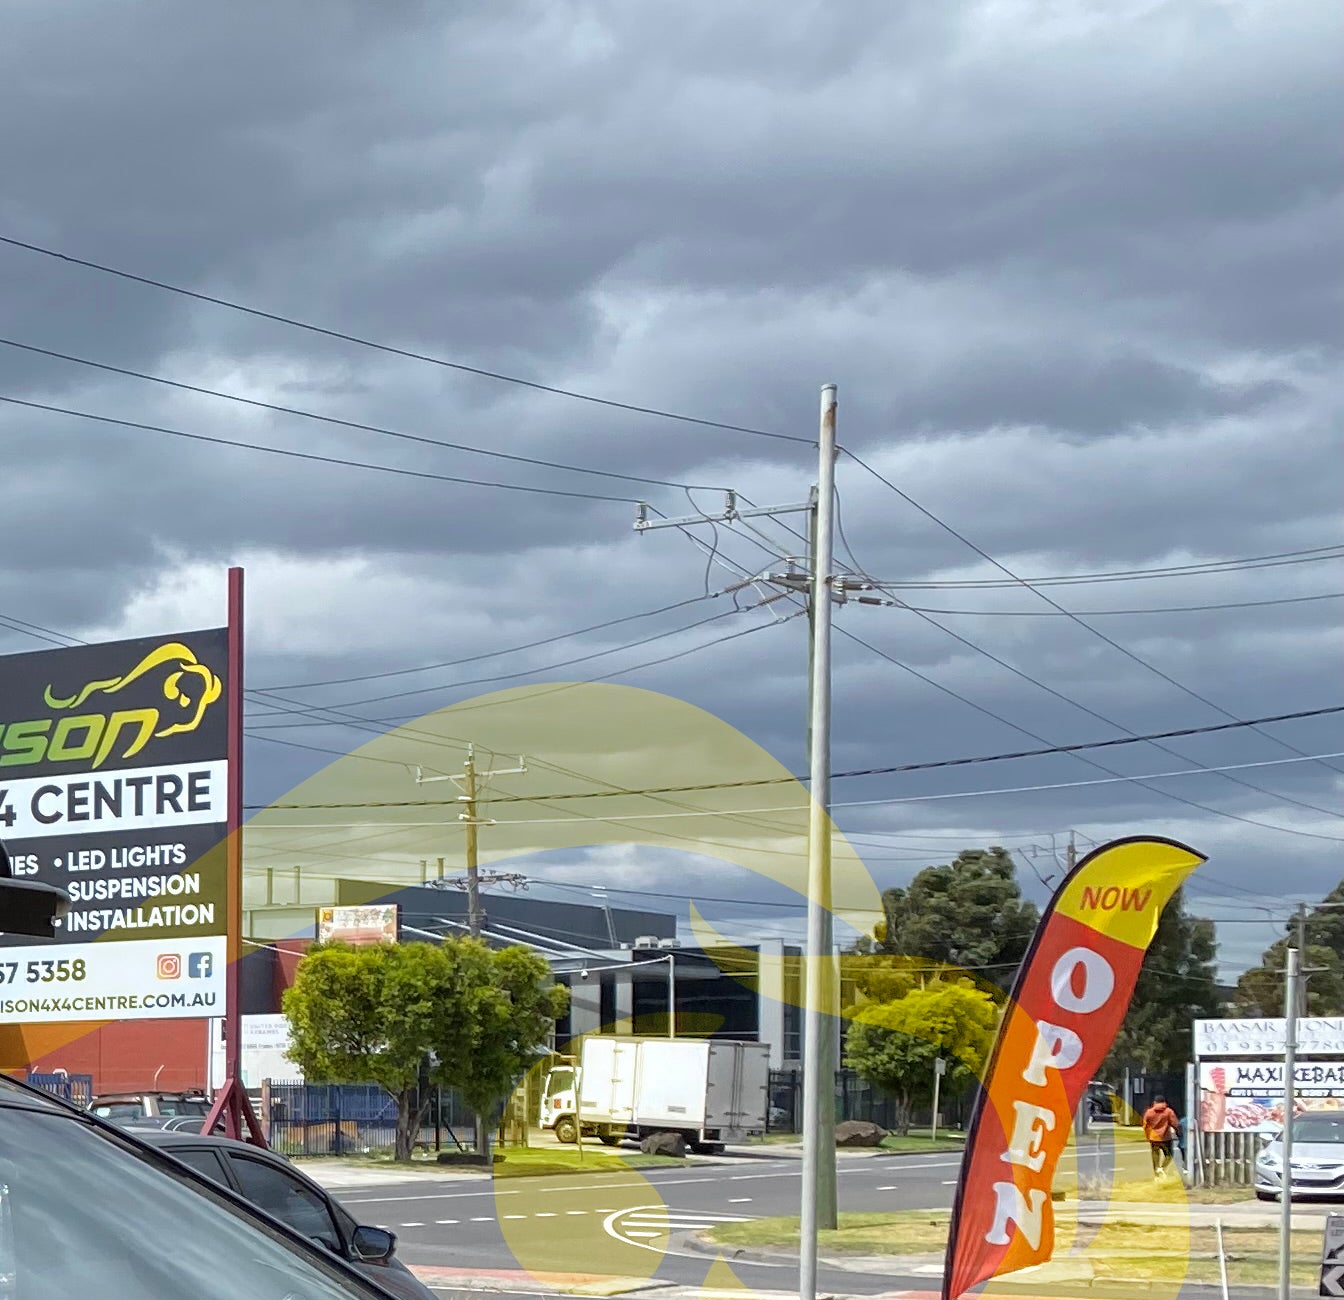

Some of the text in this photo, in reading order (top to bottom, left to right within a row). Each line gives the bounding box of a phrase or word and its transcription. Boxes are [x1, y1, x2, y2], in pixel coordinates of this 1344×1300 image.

[30, 770, 211, 824] CENTRE
[67, 843, 187, 872] LED LIGHTS
[67, 872, 200, 902] SUSPENSION
[1079, 886, 1152, 912] NOW
[67, 902, 215, 932] INSTALLATION
[25, 958, 87, 983] 5358
[1203, 1021, 1278, 1033] BAASAR
[1236, 1066, 1283, 1084] MAXI
[984, 946, 1115, 1252] OPEN
